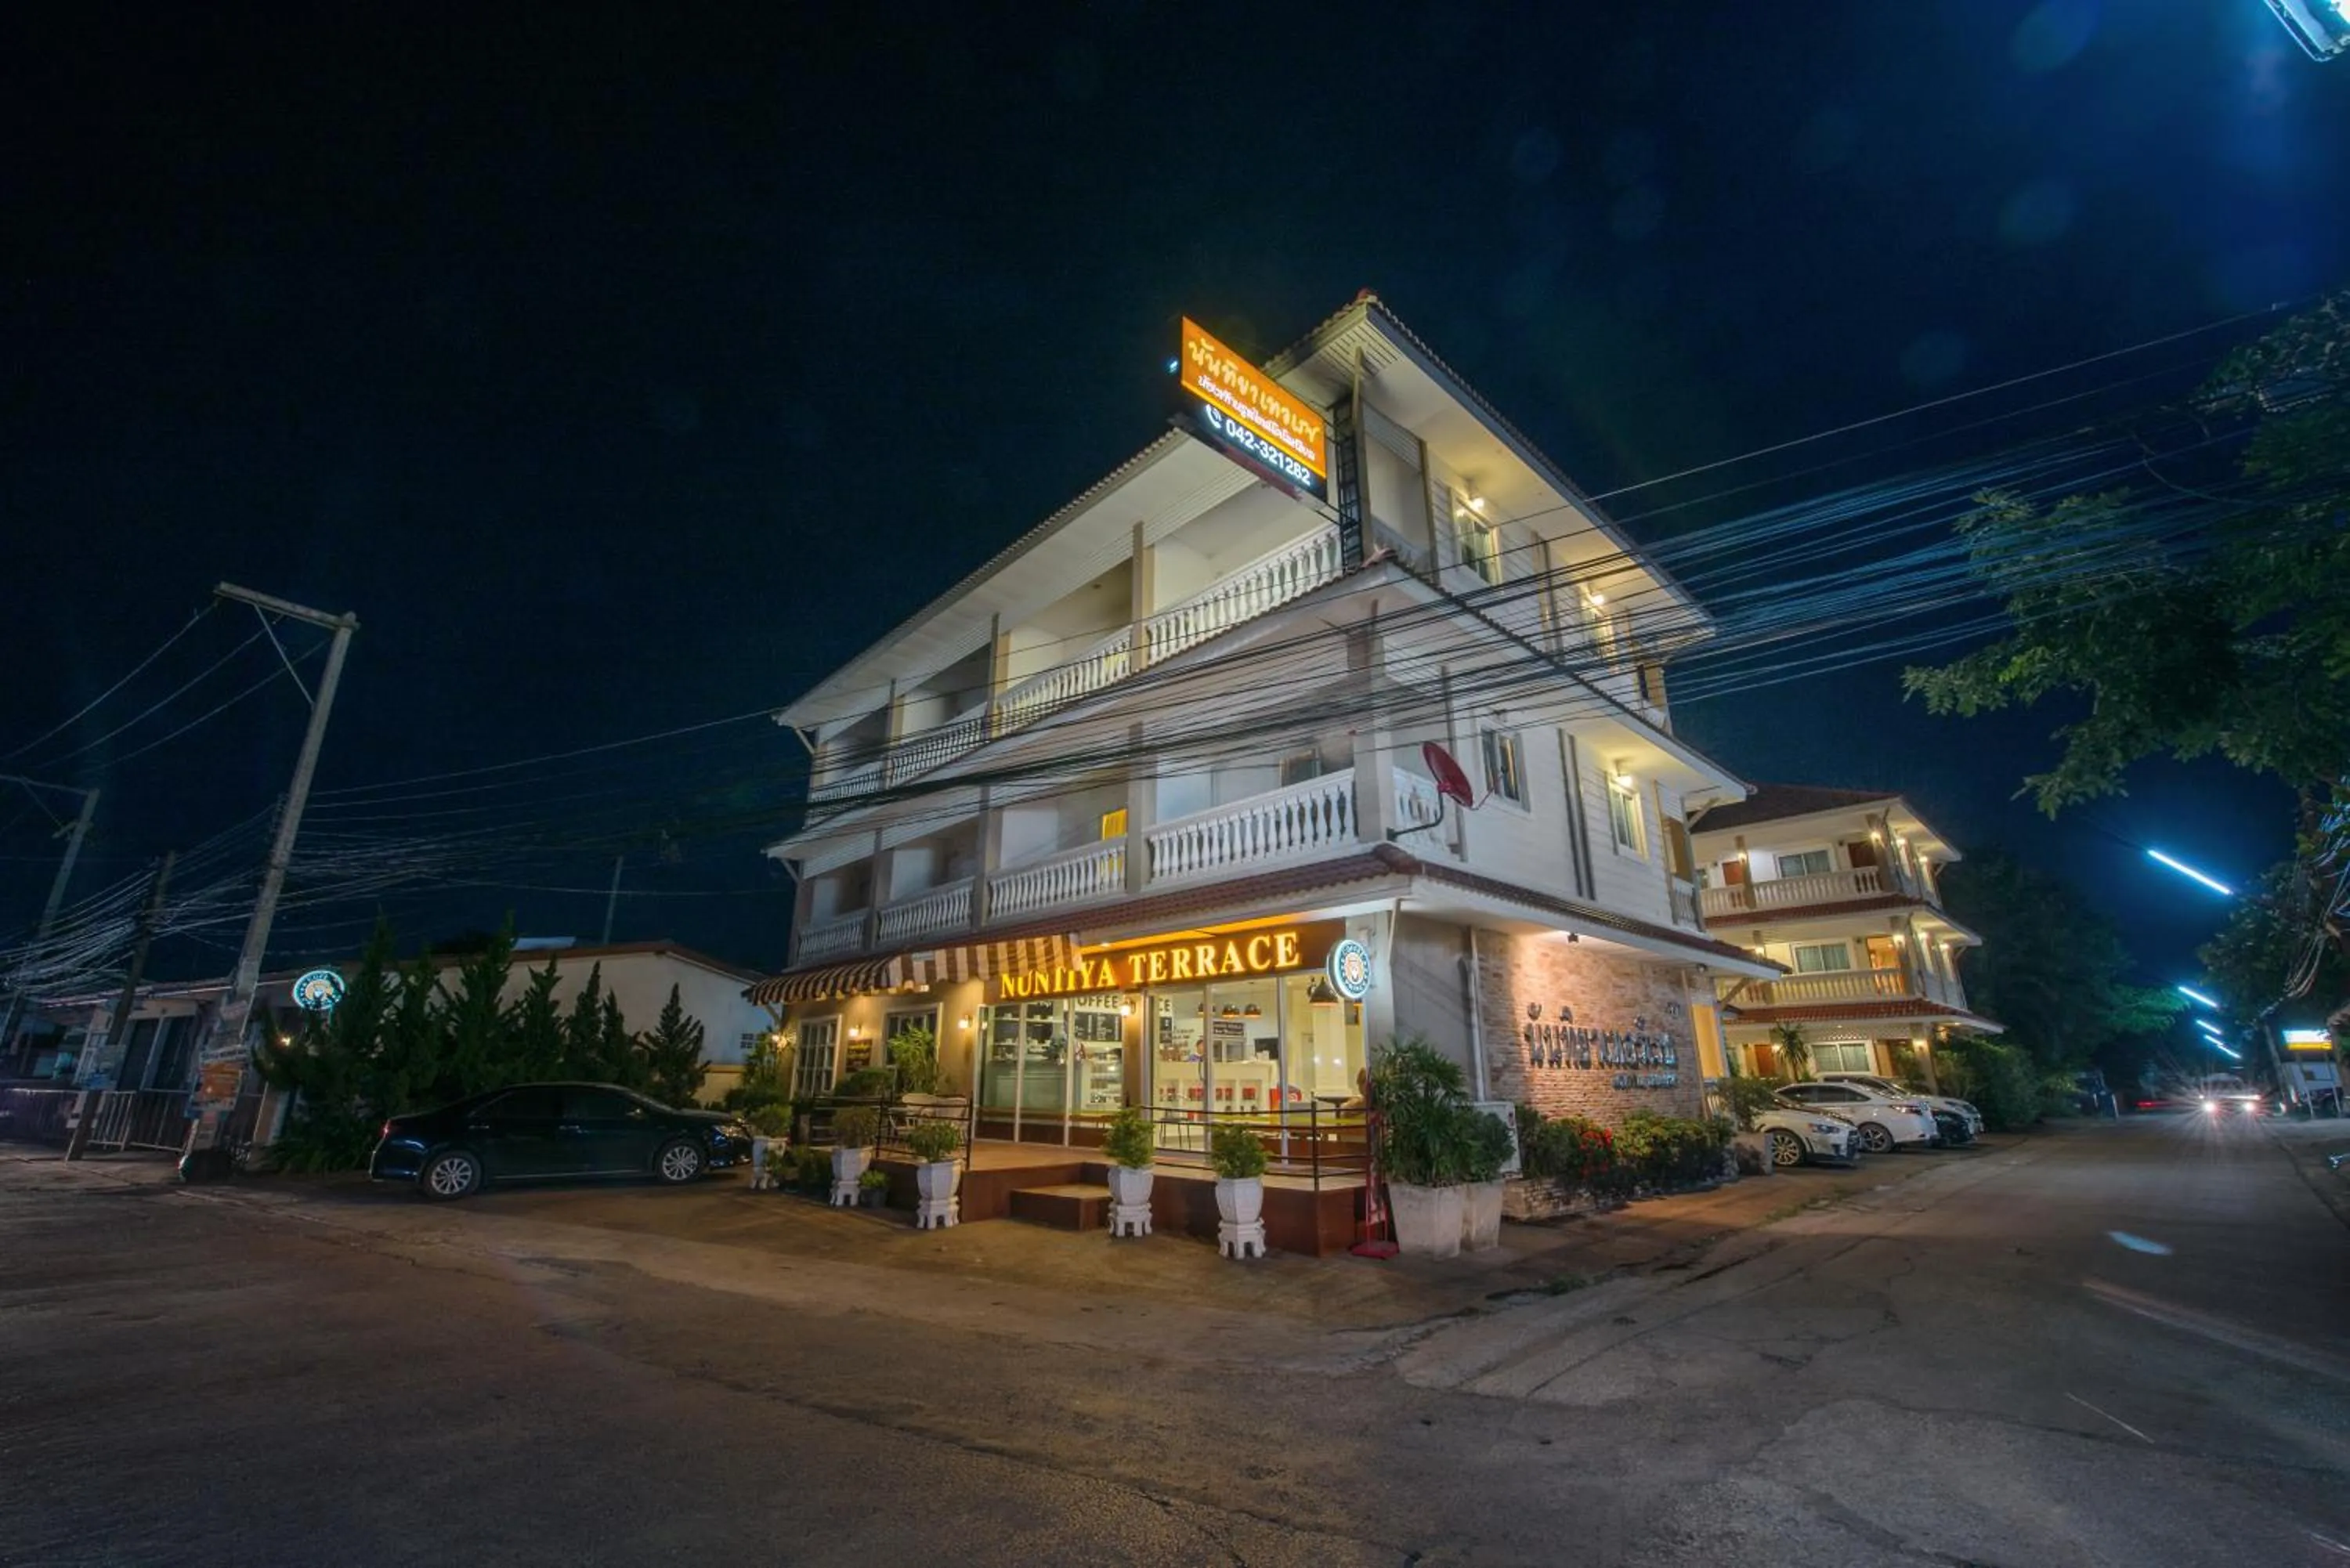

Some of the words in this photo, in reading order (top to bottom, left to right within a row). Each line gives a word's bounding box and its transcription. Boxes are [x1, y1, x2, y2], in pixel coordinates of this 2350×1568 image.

[1225, 419, 1311, 486] 042-321282
[1129, 931, 1300, 984] TERRACE
[1077, 995, 1119, 1009] OFFEE
